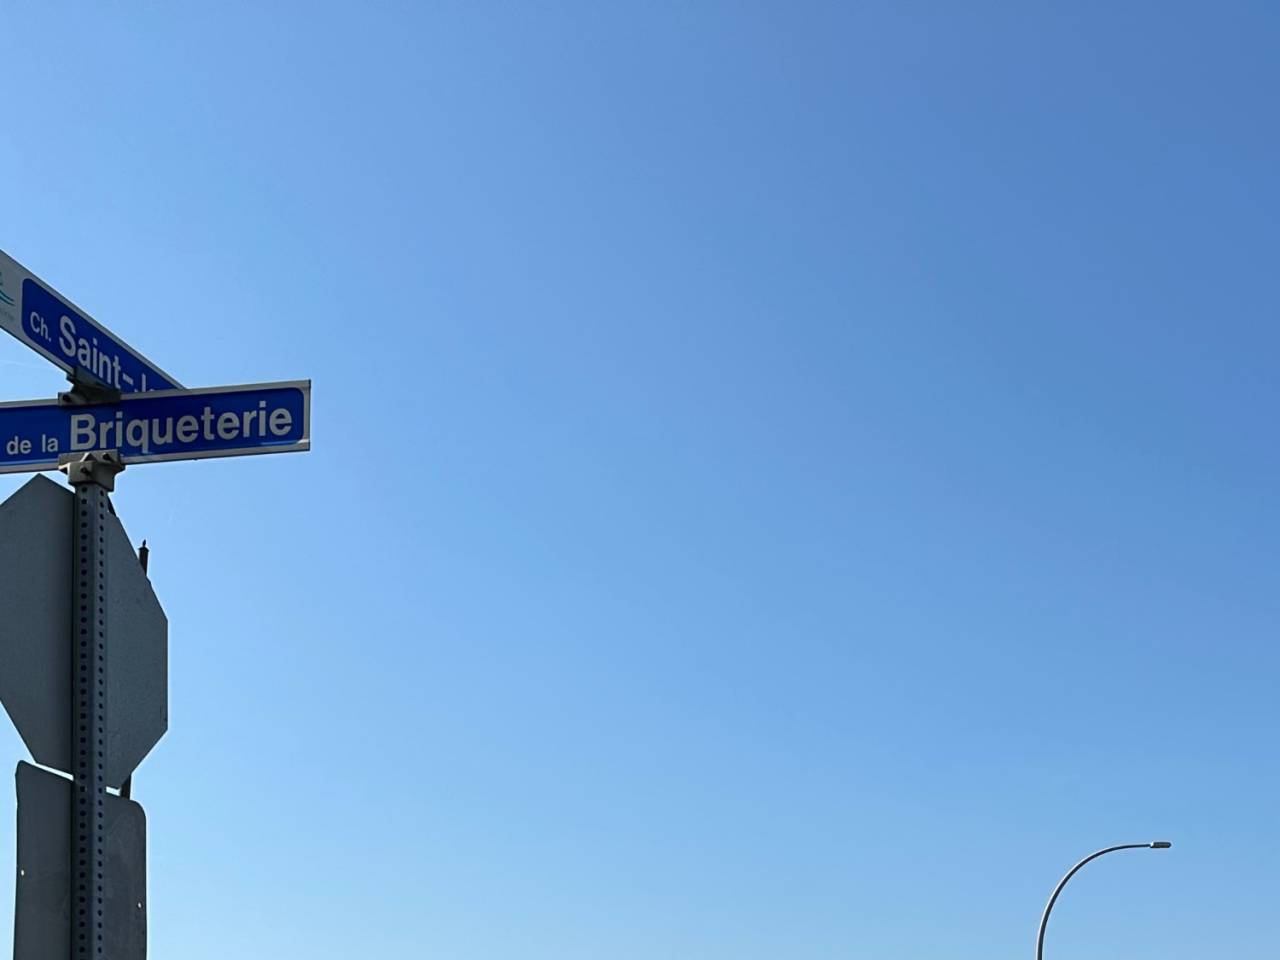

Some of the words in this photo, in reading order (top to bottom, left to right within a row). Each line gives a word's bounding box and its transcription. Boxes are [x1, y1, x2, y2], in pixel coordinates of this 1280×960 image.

[29, 311, 51, 342] Ch.
[58, 315, 156, 393] Saint-J
[6, 435, 32, 455] de
[41, 433, 59, 453] la
[69, 400, 293, 453] Briqueterie
